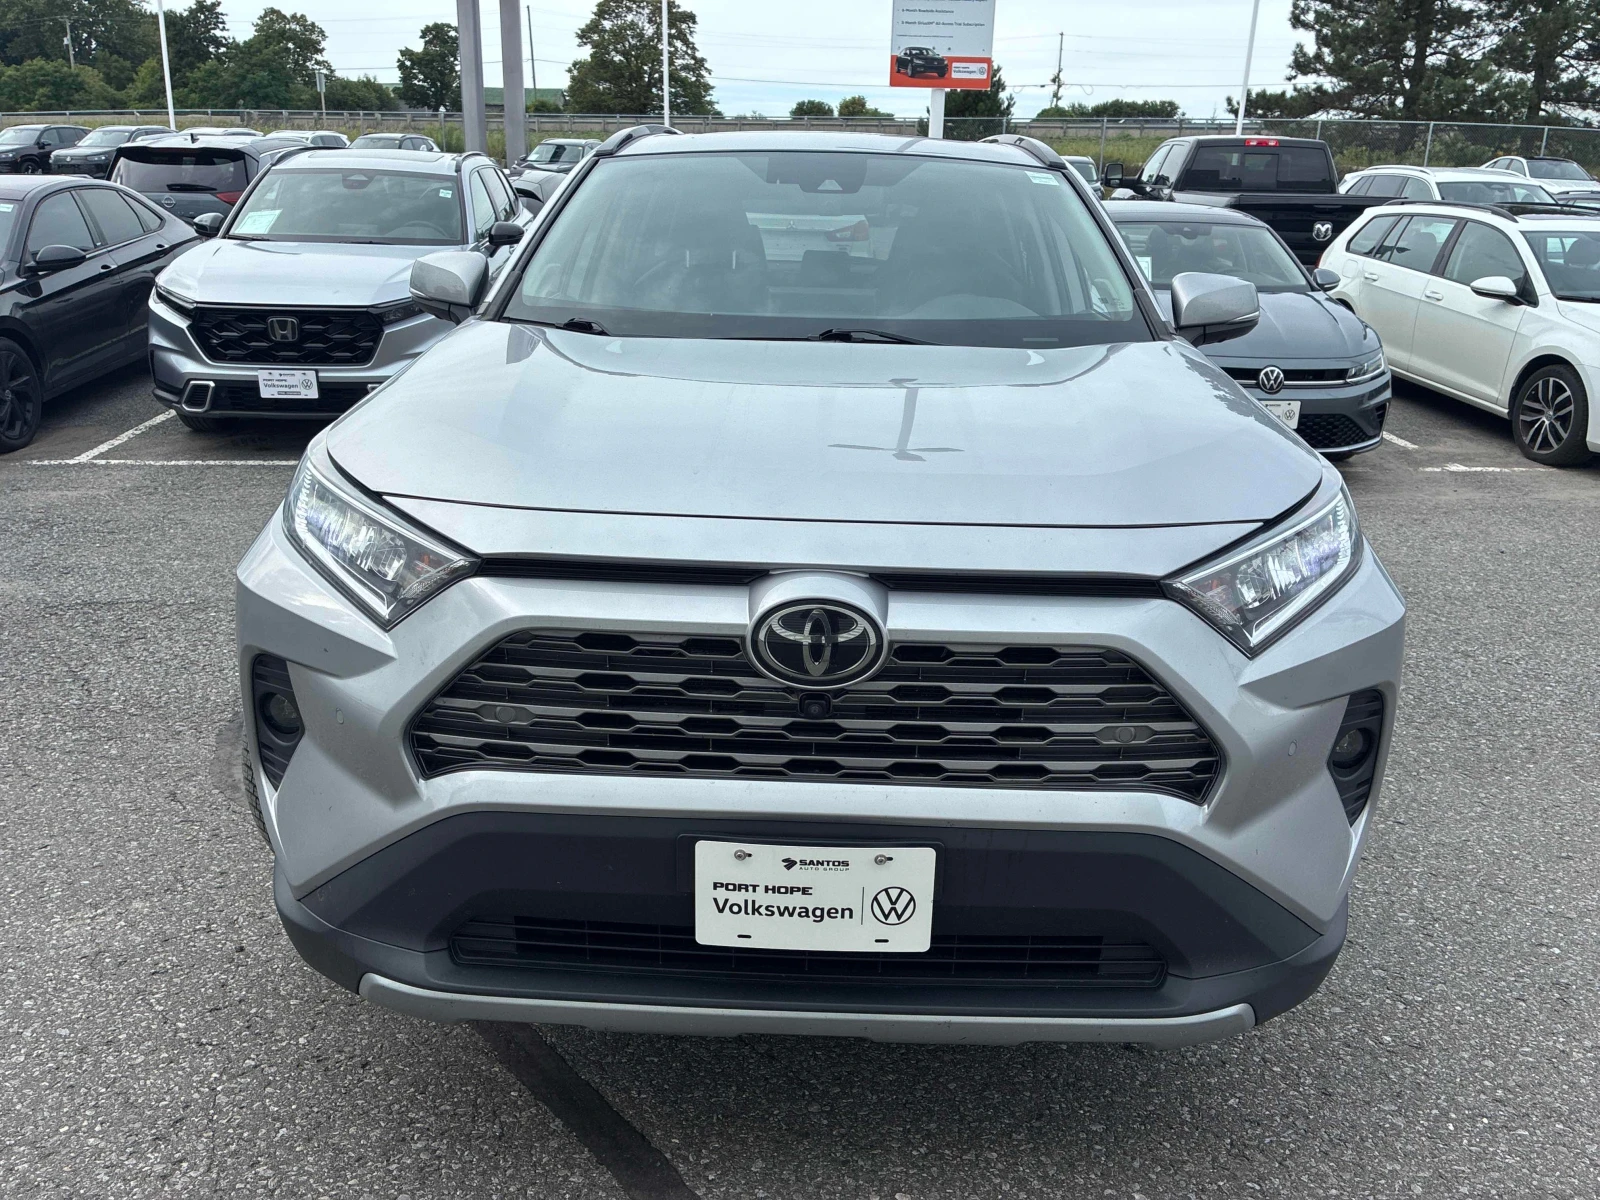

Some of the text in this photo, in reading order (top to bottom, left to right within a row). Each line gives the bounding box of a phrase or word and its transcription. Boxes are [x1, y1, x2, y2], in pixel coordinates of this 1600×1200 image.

[799, 859, 850, 867] SANTOS
[712, 881, 813, 895] PORT HOPE
[712, 897, 854, 923] Volkswagen
